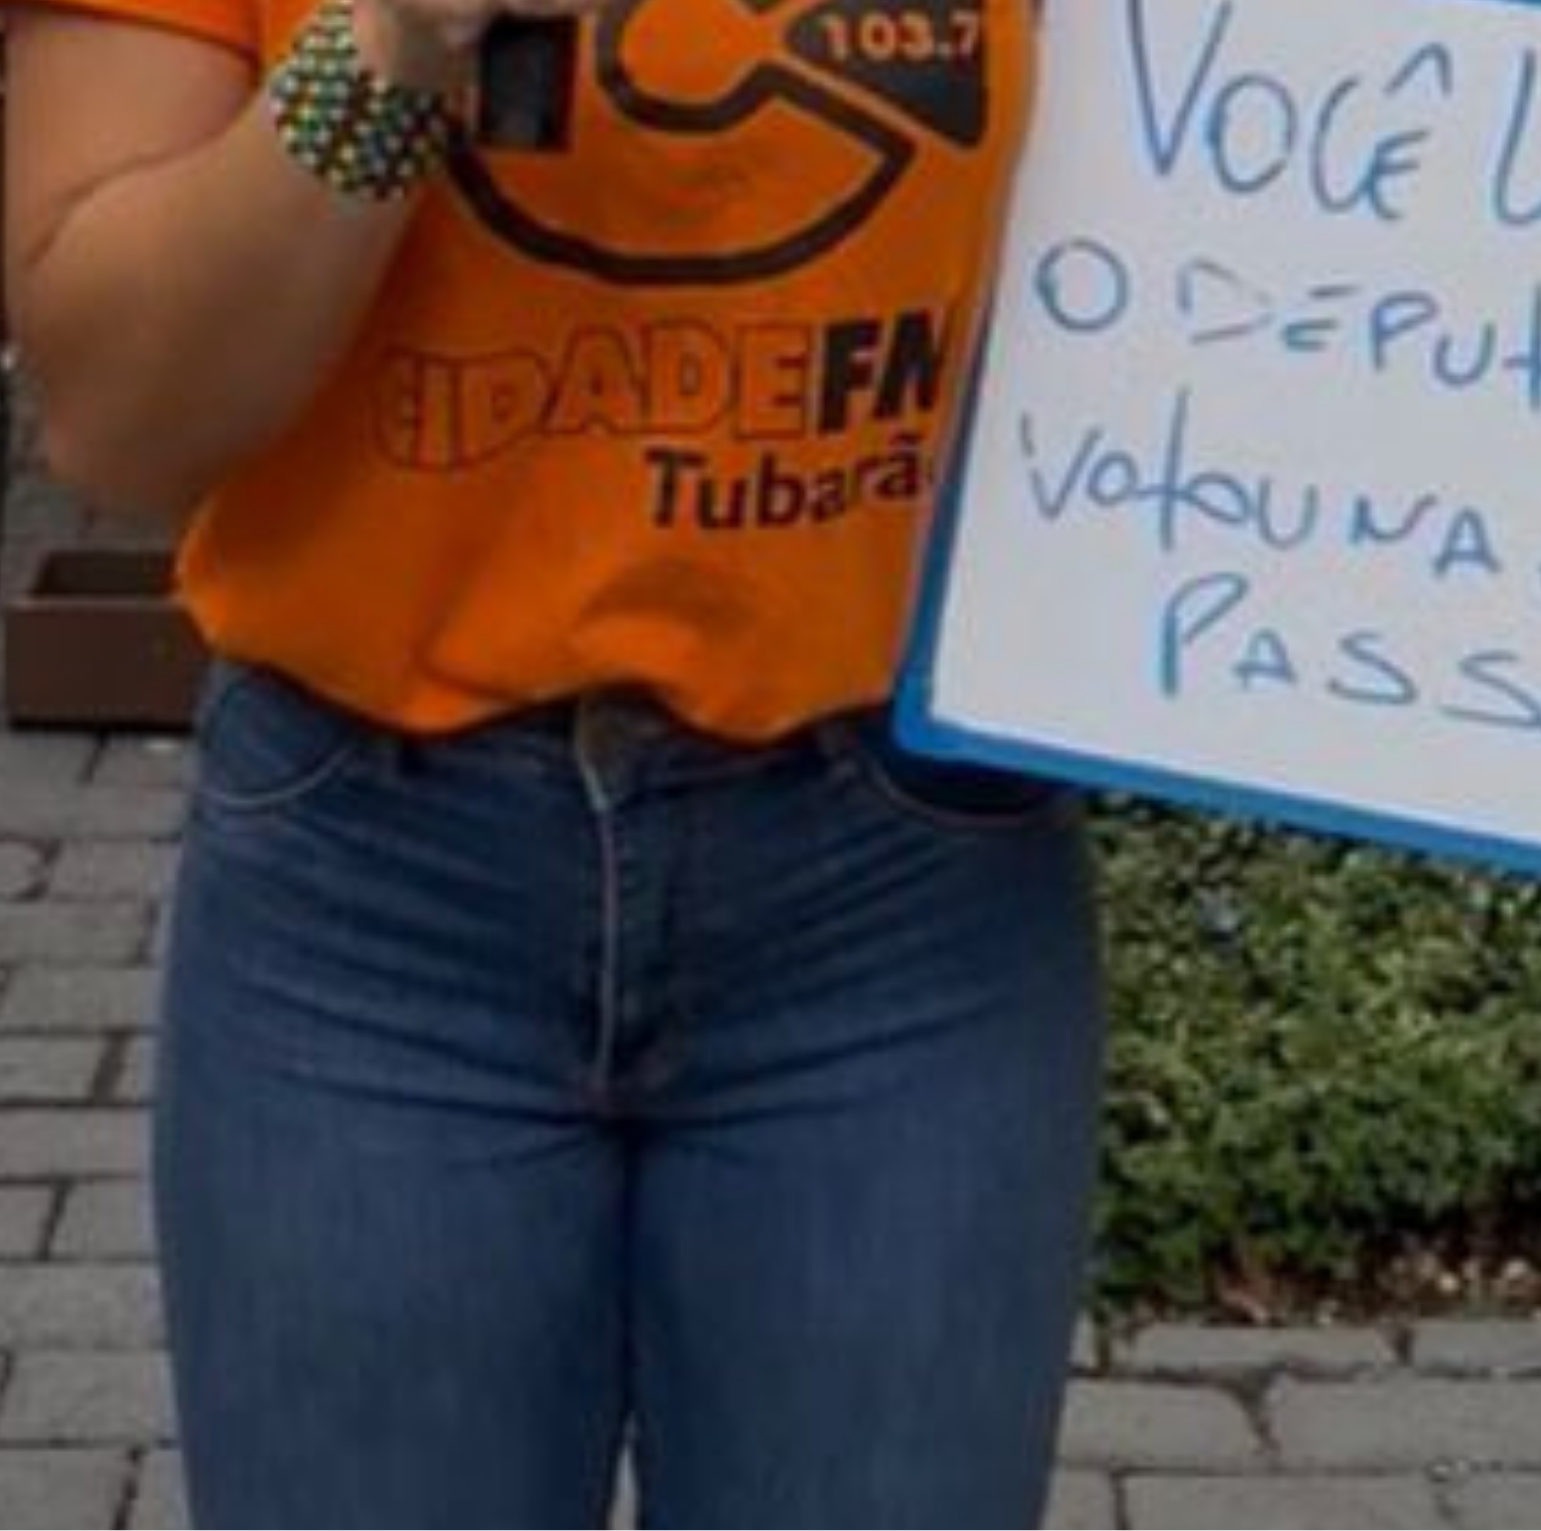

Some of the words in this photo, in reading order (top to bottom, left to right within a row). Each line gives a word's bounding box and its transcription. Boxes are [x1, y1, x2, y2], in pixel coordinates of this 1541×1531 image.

[820, 8, 981, 61] 103.7
[1035, 236, 1131, 334] O
[645, 432, 938, 530] Tubarã
